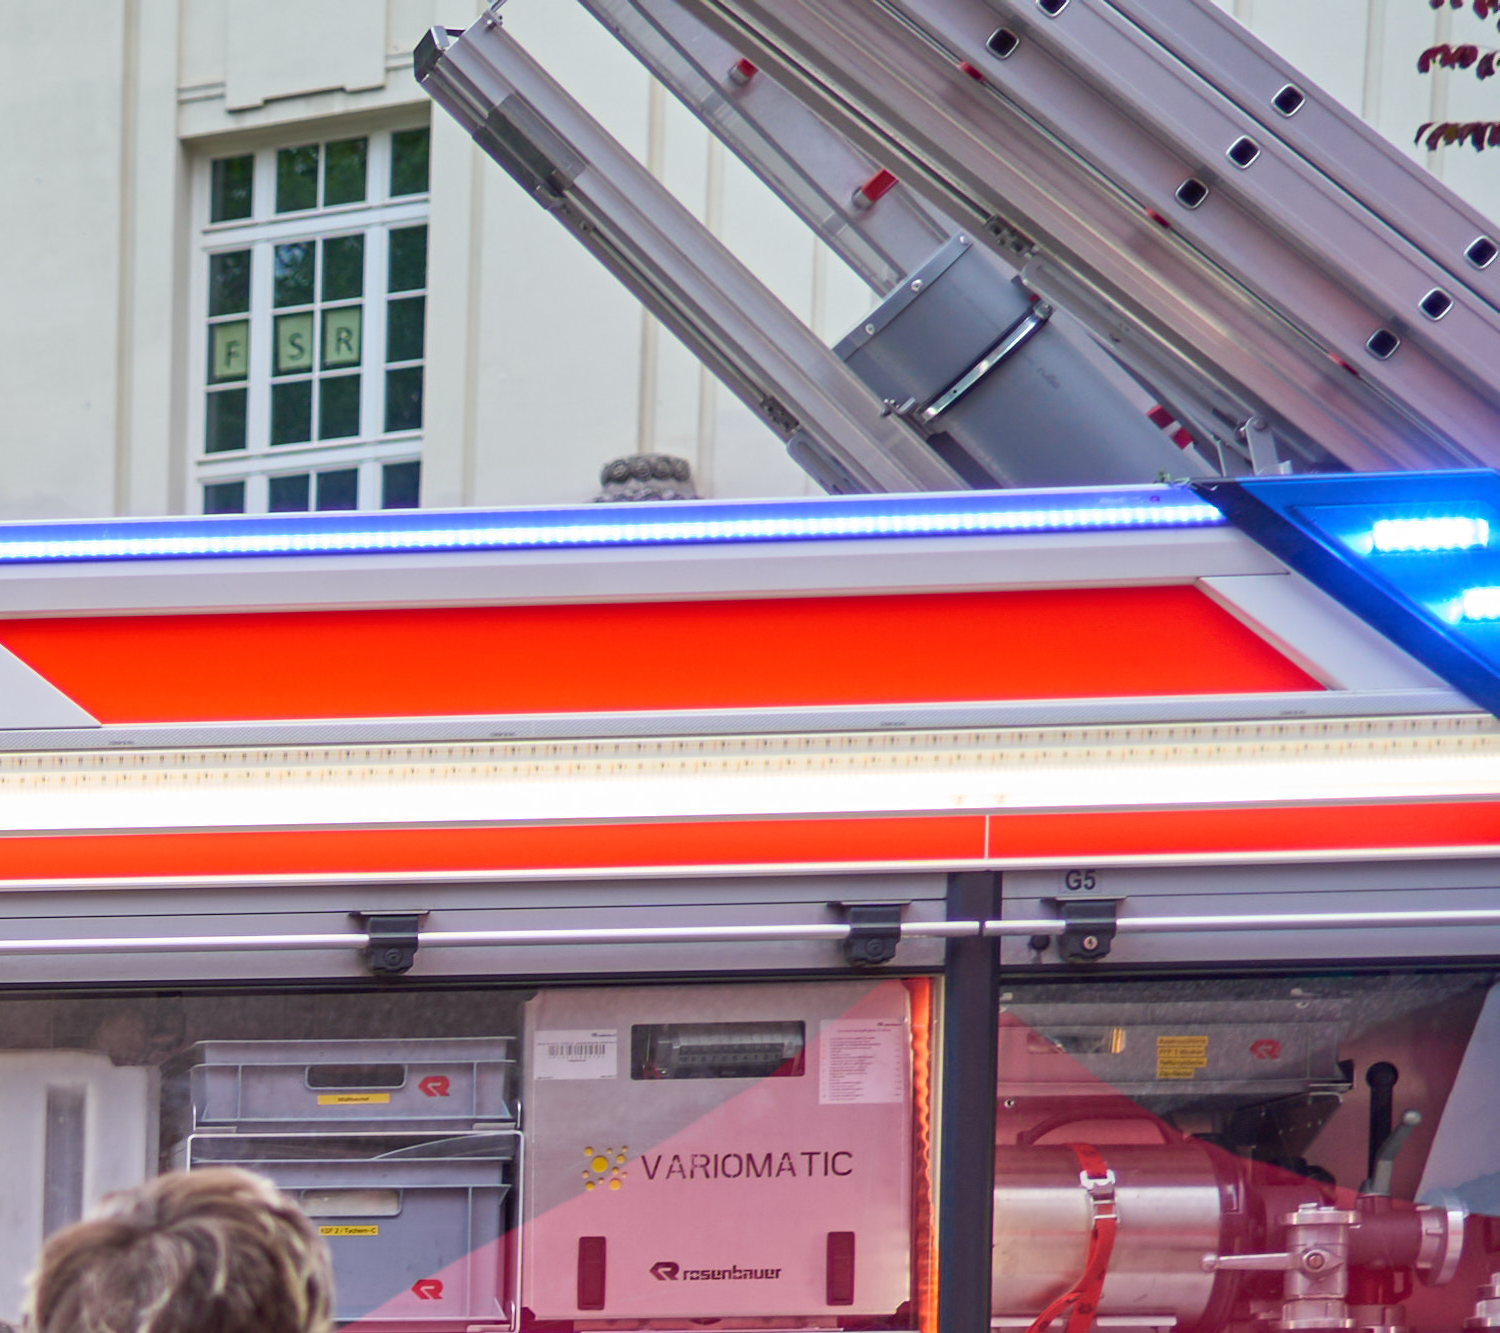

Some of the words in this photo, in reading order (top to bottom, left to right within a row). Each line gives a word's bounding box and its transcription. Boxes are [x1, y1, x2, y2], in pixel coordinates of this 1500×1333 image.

[1065, 870, 1097, 890] G5
[641, 1151, 854, 1180] VARIOMATIC
[683, 1264, 782, 1282] rosenbauer
